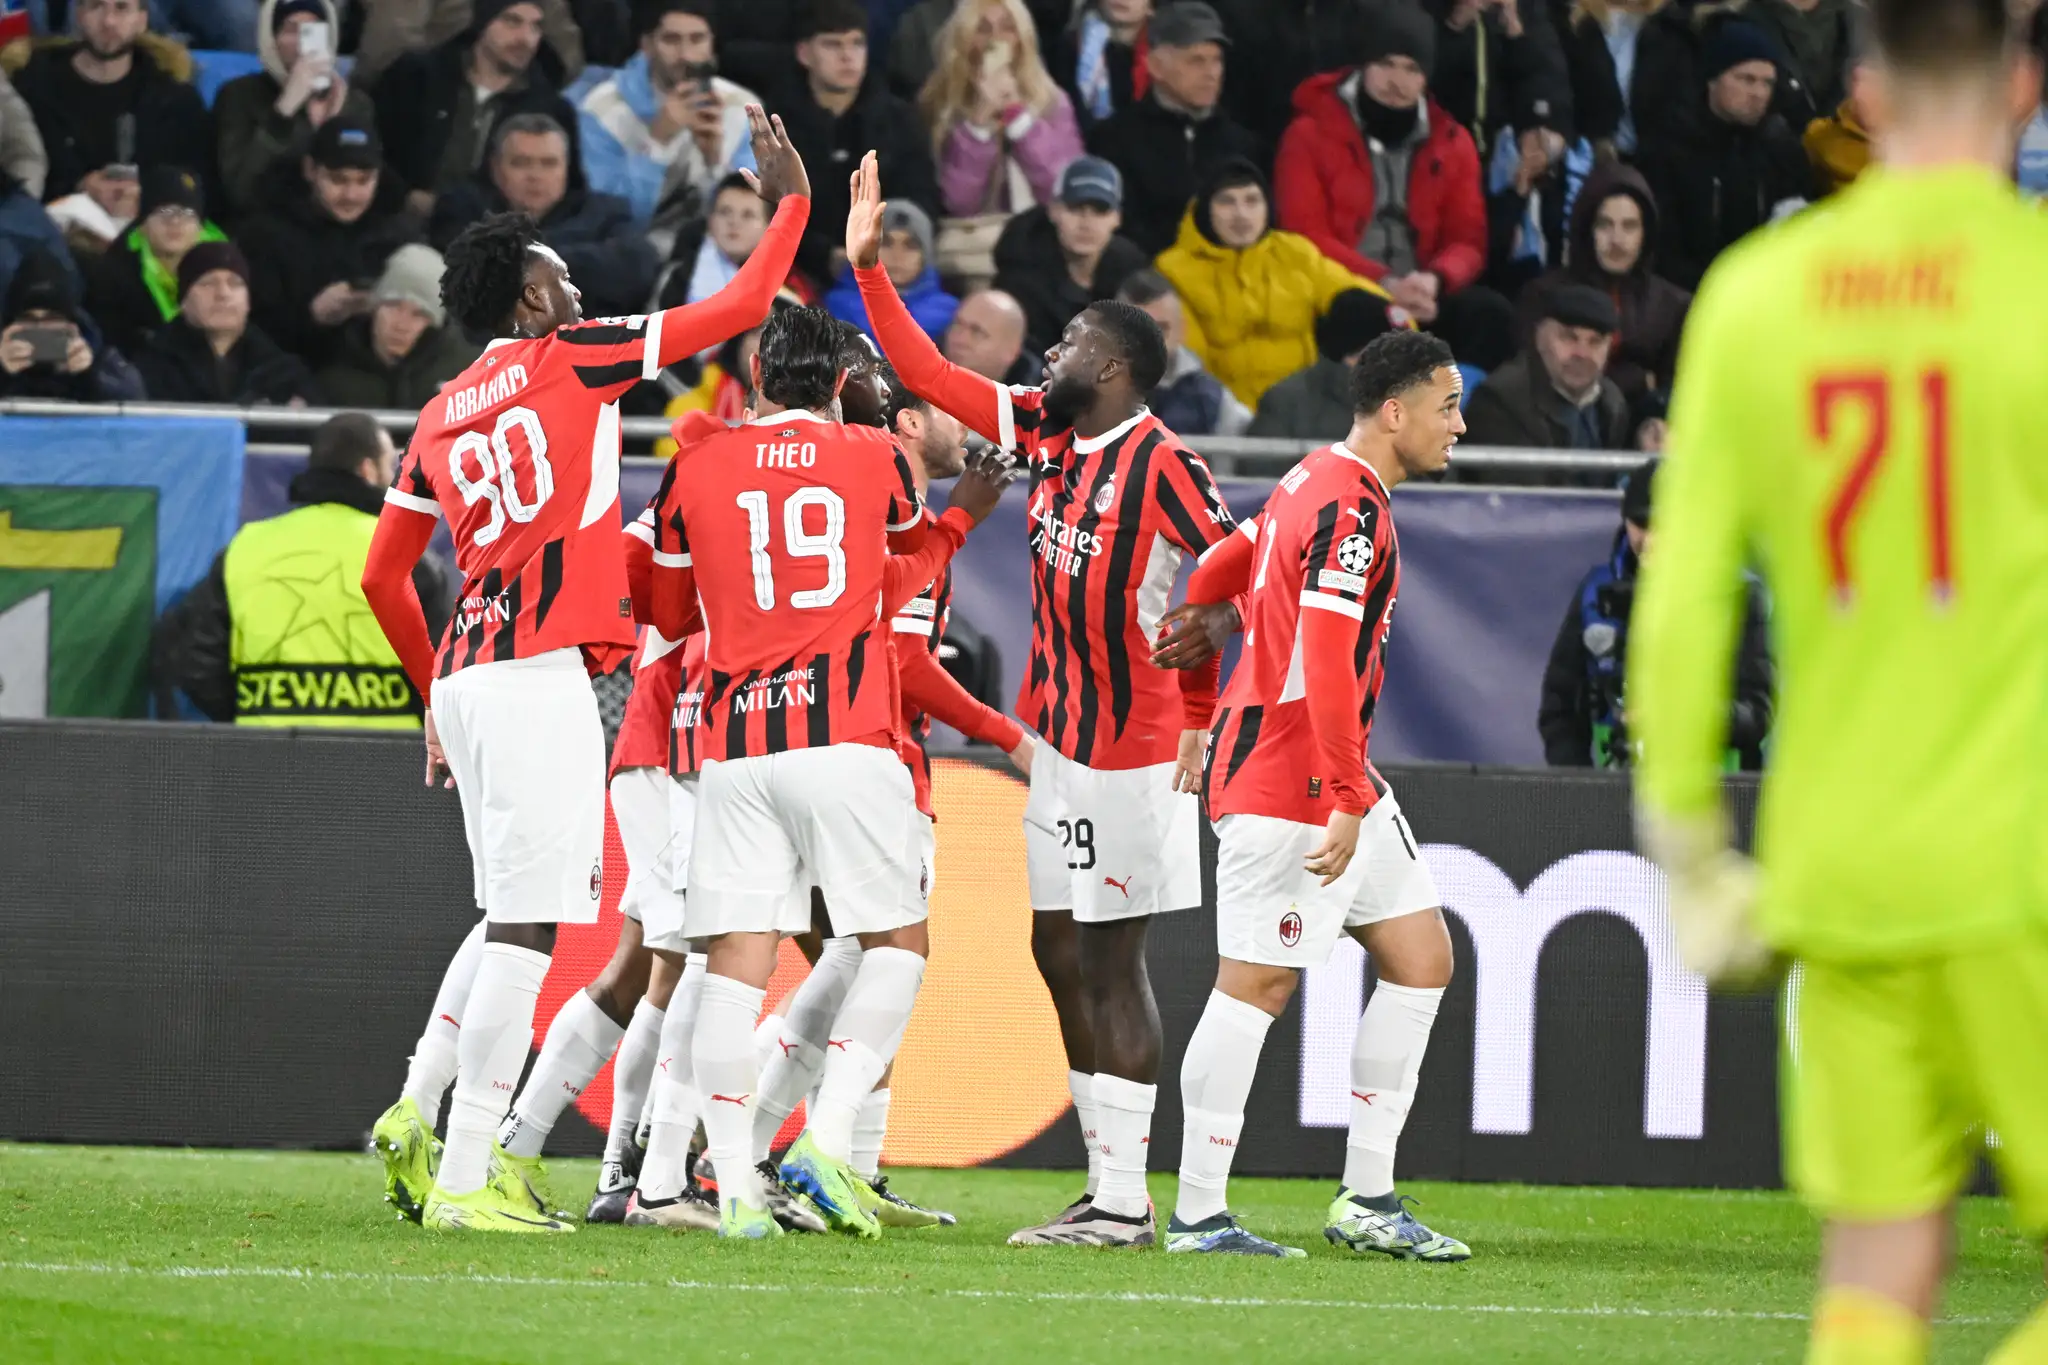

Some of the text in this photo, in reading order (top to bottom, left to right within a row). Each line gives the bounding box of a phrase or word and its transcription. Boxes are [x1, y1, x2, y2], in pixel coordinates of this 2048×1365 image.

[444, 363, 529, 426] ABRAHAM
[448, 405, 555, 547] 90
[756, 442, 817, 469] THEO
[1811, 366, 1951, 609] 71
[736, 486, 847, 611] 19
[237, 671, 411, 709] STEWARD
[734, 683, 816, 715] MILAN
[1057, 818, 1097, 870] 29
